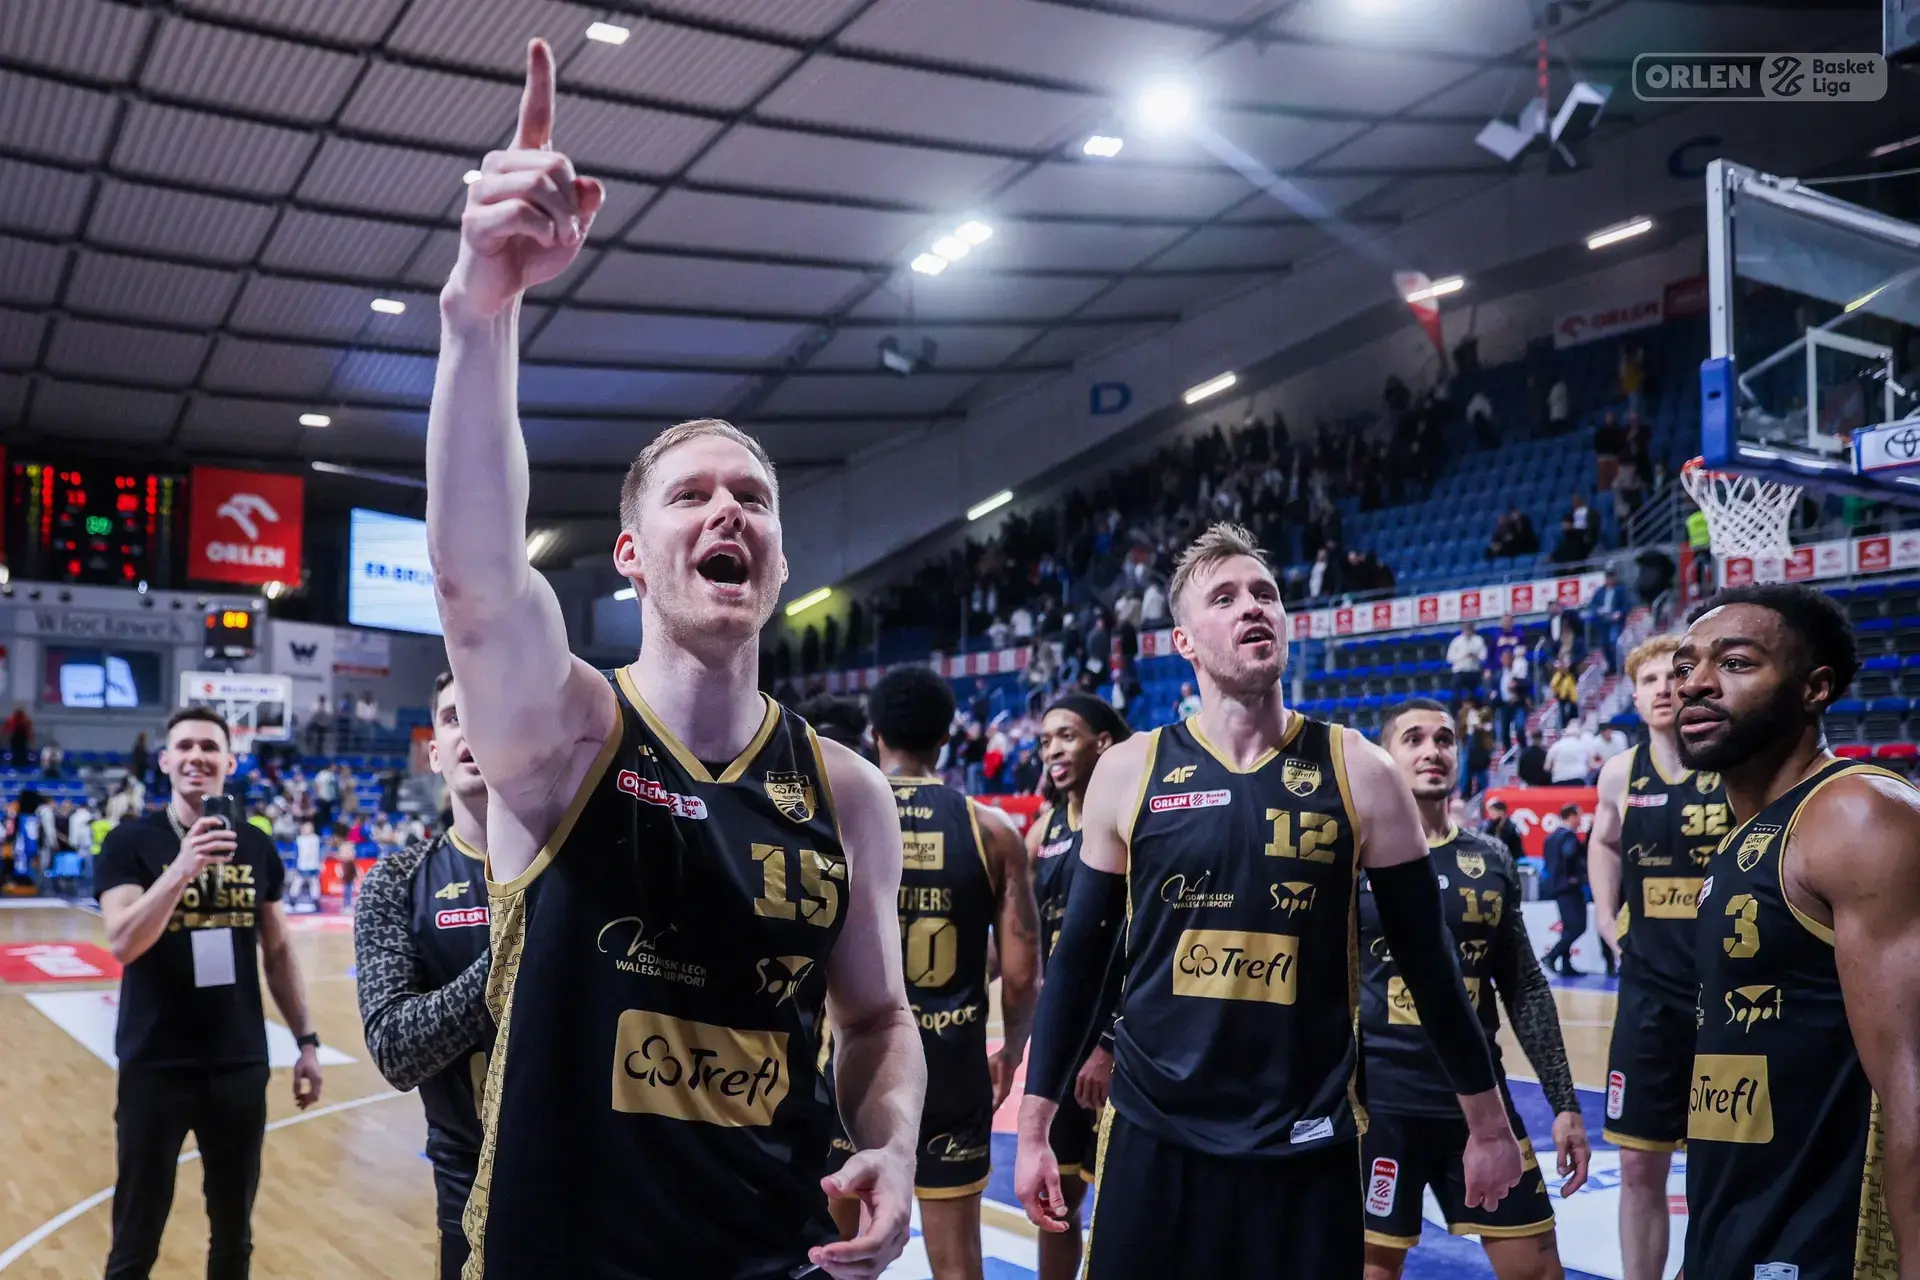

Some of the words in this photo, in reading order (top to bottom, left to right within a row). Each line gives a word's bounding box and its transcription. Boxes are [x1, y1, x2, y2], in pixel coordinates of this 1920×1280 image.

[1090, 382, 1132, 415] D
[206, 541, 286, 569] ORLEN
[1153, 797, 1188, 809] ORLEN
[1680, 803, 1730, 836] 32
[1264, 808, 1338, 865] 12
[751, 842, 848, 929] 15
[1216, 893, 1234, 901] LECH
[440, 911, 484, 925] ORLEN
[1458, 887, 1504, 926] 13
[1723, 893, 1760, 958] 3
[615, 959, 662, 977] WALESA
[1221, 948, 1293, 987] Trefl
[688, 1047, 780, 1107] Trefl
[1699, 1075, 1759, 1123] Trefl
